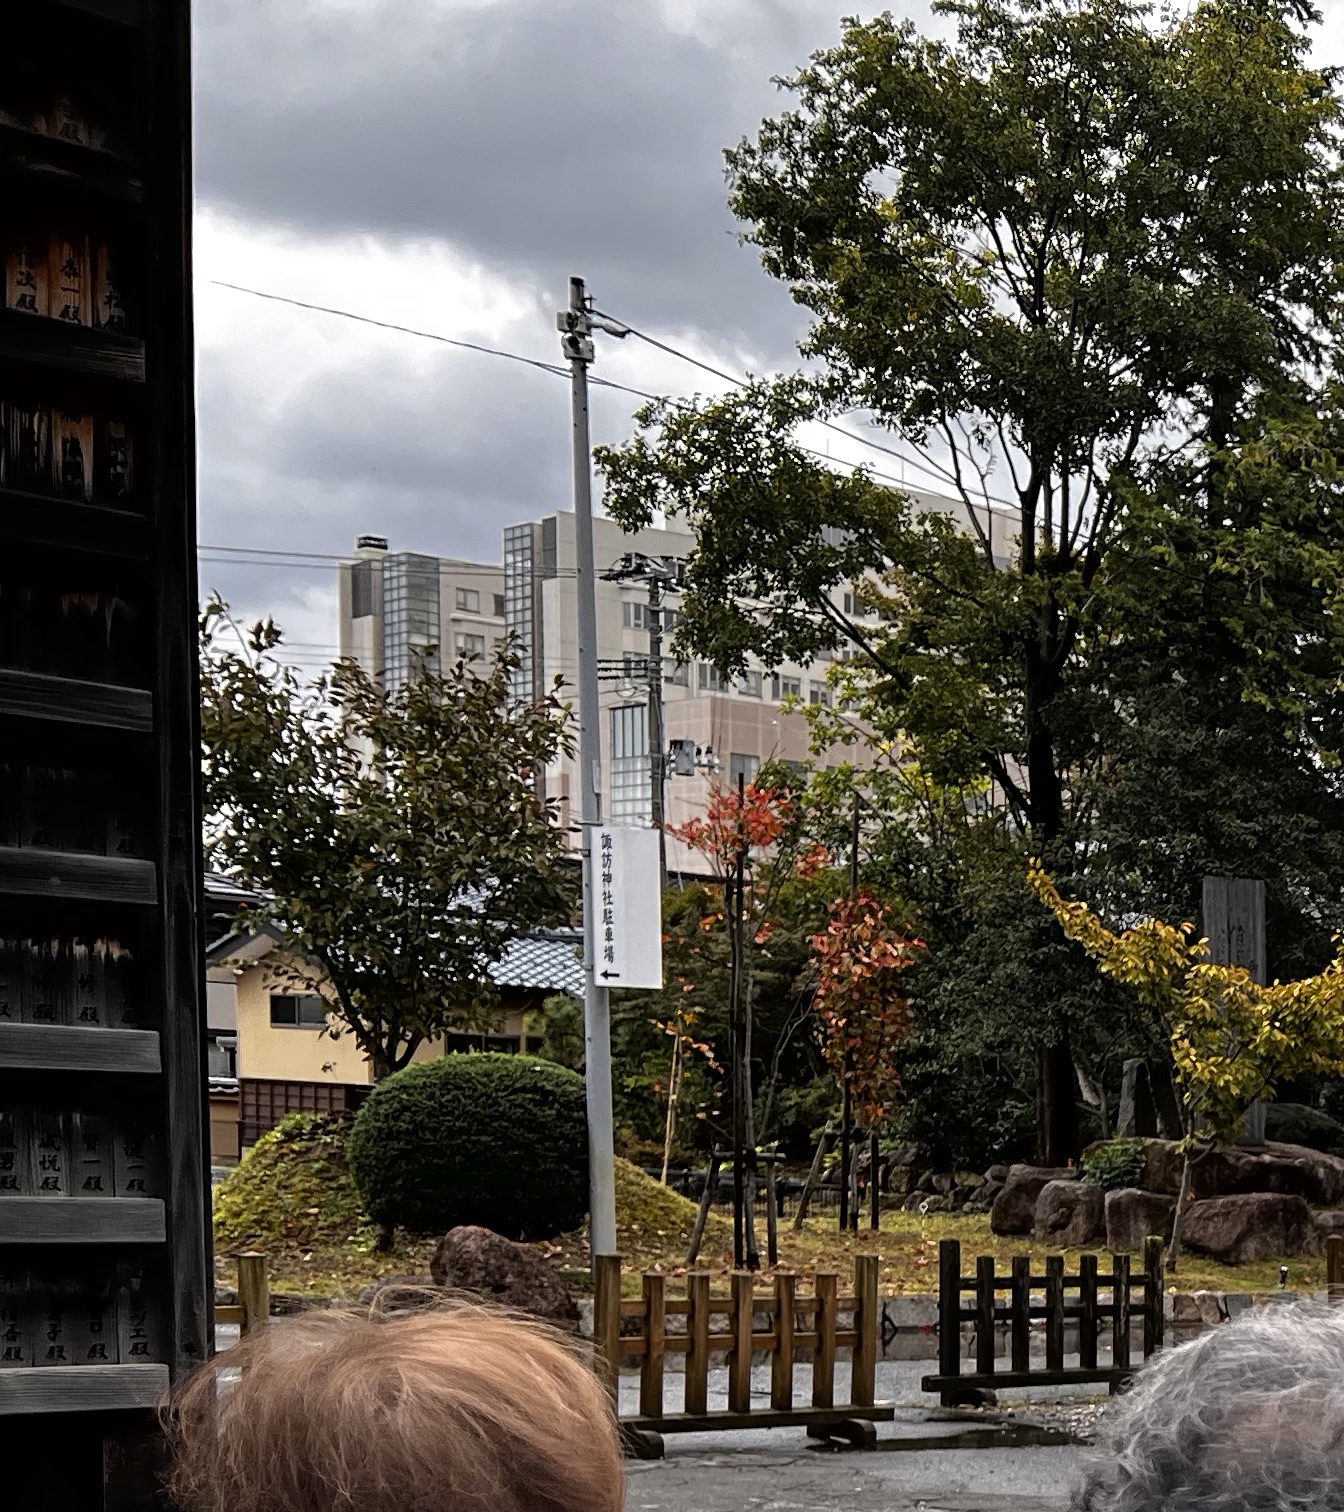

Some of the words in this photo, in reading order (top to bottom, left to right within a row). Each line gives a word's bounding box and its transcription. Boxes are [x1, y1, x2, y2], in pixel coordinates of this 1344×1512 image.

[600, 832, 614, 965] 諏訪神社駐車場
